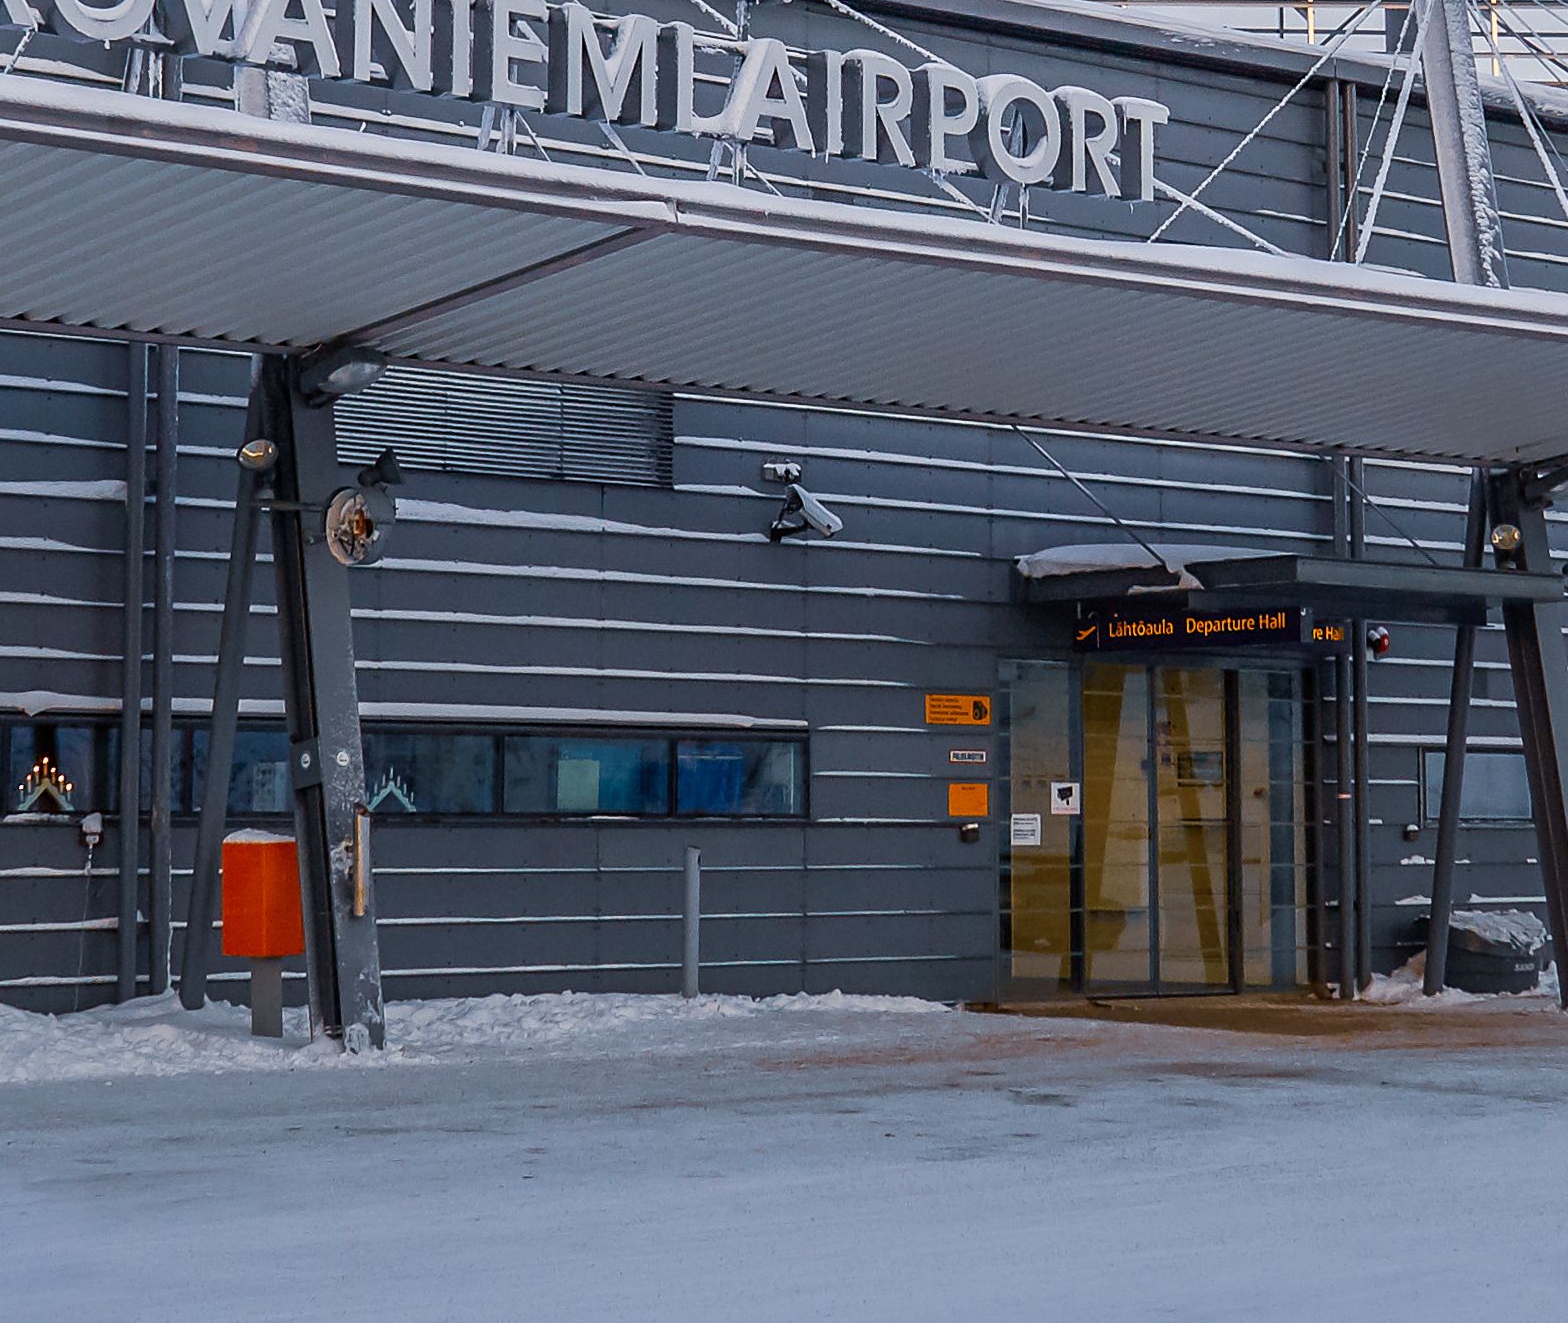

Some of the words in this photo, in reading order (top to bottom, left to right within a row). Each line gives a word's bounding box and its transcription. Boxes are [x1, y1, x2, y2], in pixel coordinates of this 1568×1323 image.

[731, 39, 1171, 203] AIRPORT
[1108, 618, 1174, 638] Lähtöaula
[1186, 617, 1255, 637] Departure
[1259, 612, 1286, 630] Hall
